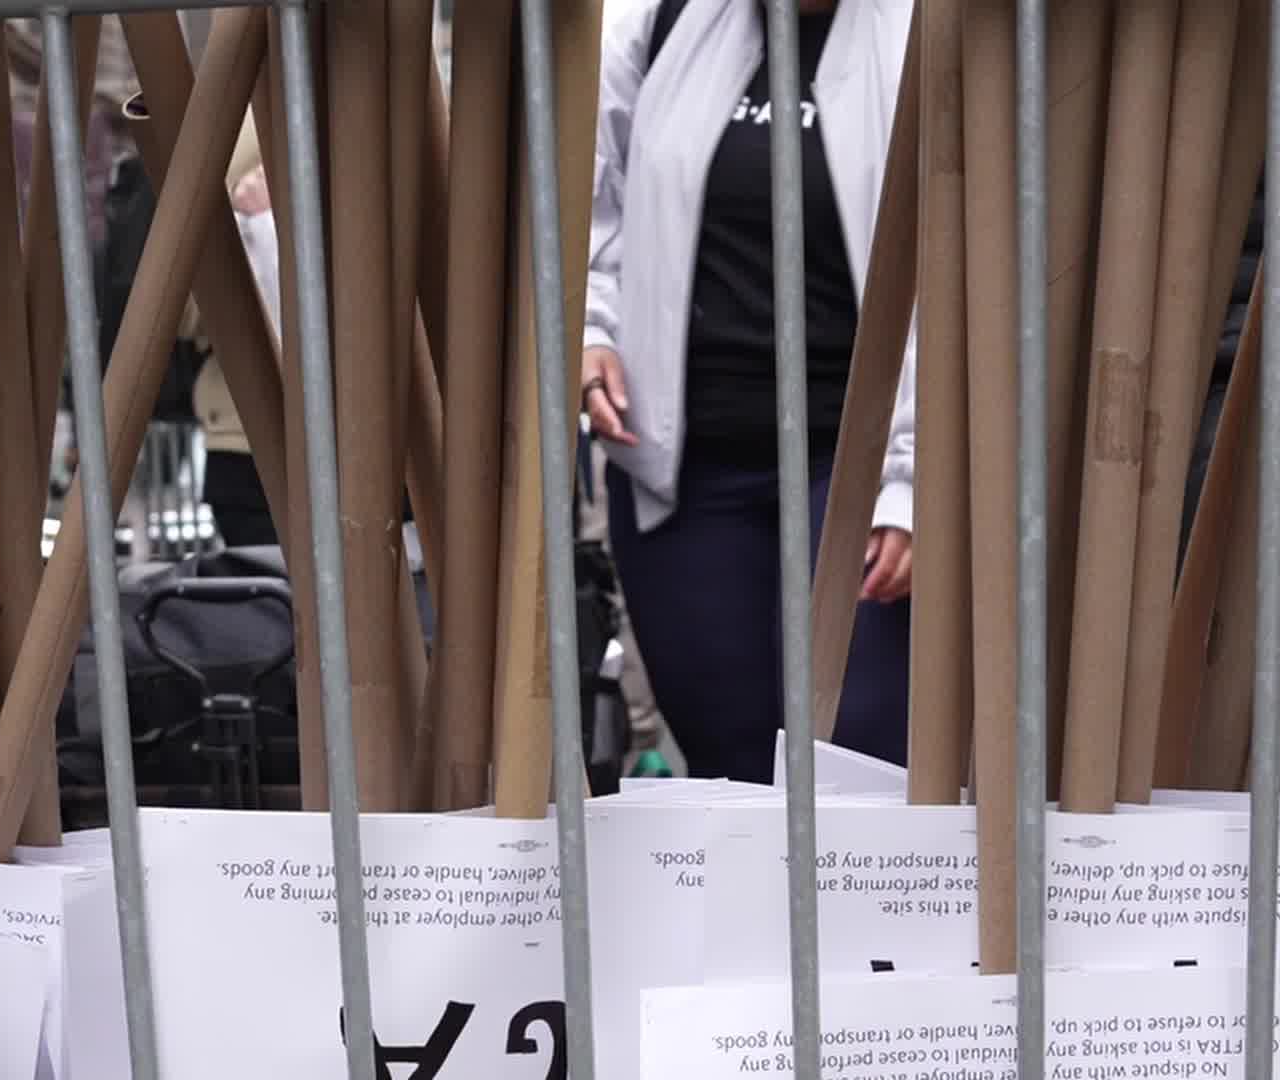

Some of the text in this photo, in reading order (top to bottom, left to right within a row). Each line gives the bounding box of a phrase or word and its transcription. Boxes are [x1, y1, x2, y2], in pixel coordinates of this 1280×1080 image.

[650, 849, 705, 869] goods.
[843, 855, 872, 869] any
[878, 855, 958, 870] transport
[217, 860, 274, 880] goods.
[280, 860, 310, 877] any
[402, 866, 419, 879] or
[424, 866, 482, 883] handle
[488, 867, 545, 884] deliver,
[1050, 862, 1113, 881] deliver,
[1119, 862, 1145, 878] up,
[1151, 862, 1184, 881] pick
[1190, 864, 1206, 879] to
[1213, 864, 1248, 881] fuse
[676, 873, 705, 887] any
[244, 883, 560, 907] ny individual to cease any
[817, 875, 1235, 904] not asking any individ ease performing an
[367, 912, 388, 927] thi
[394, 912, 410, 925] at
[417, 909, 496, 929] employer
[501, 912, 542, 927] other
[548, 907, 560, 921] ny
[878, 901, 1246, 927] ispute with any other at this site.
[1051, 1018, 1078, 1034] up,
[1084, 1017, 1118, 1036] pick
[1124, 1018, 1141, 1032] to
[1148, 1016, 1201, 1033] refuse
[1208, 1016, 1225, 1029] to
[711, 1032, 767, 1052] goods.
[773, 1032, 793, 1048] ny
[896, 1028, 914, 1043] or
[920, 1025, 977, 1043] handle
[1046, 1040, 1077, 1057] any
[1082, 1040, 1138, 1058] asking
[1143, 1040, 1172, 1054] not
[1178, 1040, 1190, 1053] is
[879, 1050, 926, 1065] cease
[931, 1049, 949, 1064] to
[739, 1057, 770, 1073] any
[1051, 1063, 1082, 1080] any
[1131, 1060, 1196, 1079] dispute
[1201, 1062, 1227, 1077] No
